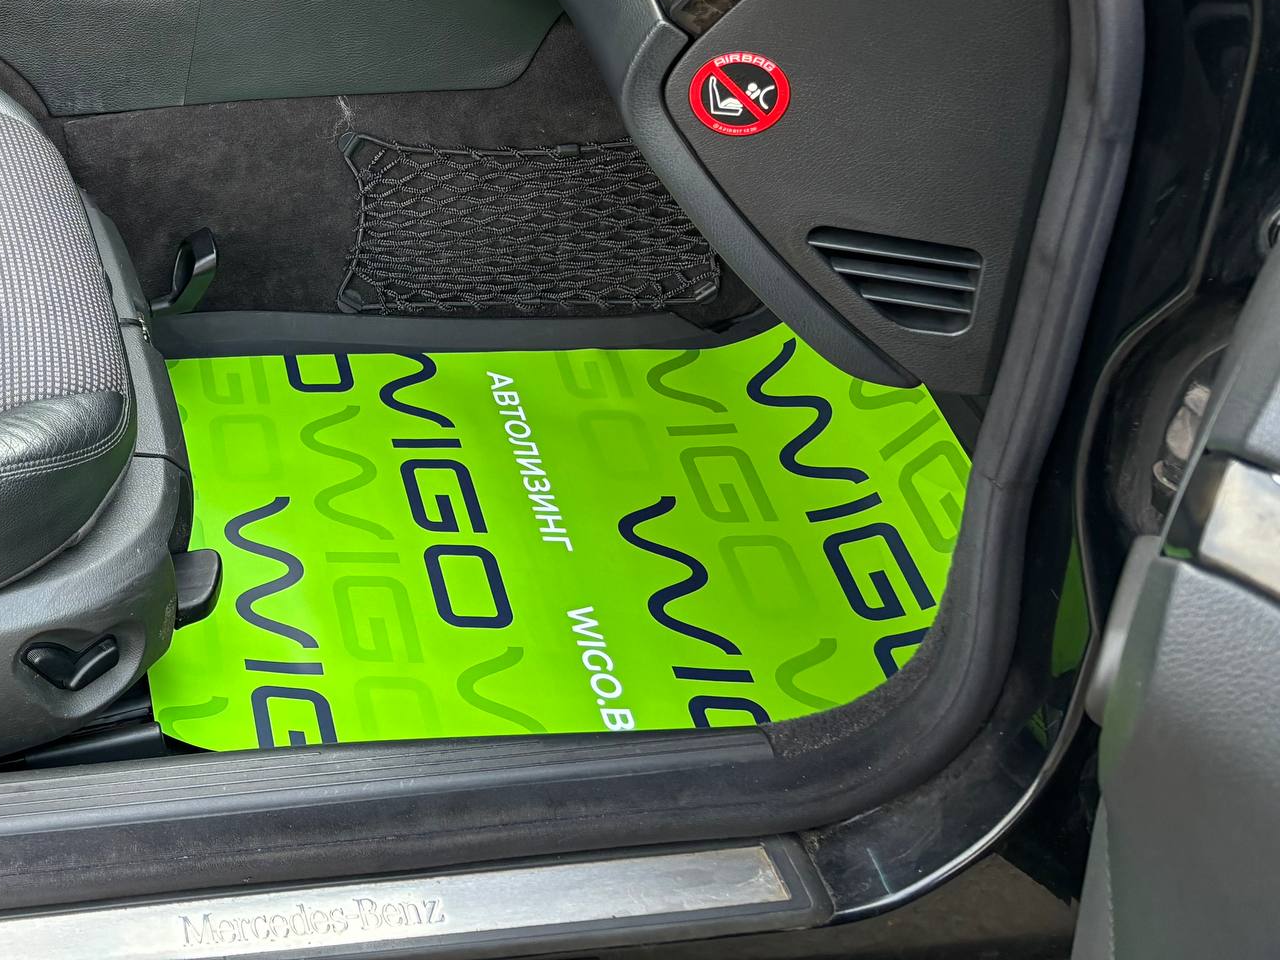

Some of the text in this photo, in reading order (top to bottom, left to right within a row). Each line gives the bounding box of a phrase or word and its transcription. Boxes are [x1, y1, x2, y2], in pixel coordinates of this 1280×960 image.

[714, 52, 776, 72] AIRBAG
[224, 497, 338, 748] WIG
[486, 371, 635, 730] АВТОЛИЗИНГ WIGO.B
[178, 897, 446, 947] Mercedes-Benz
